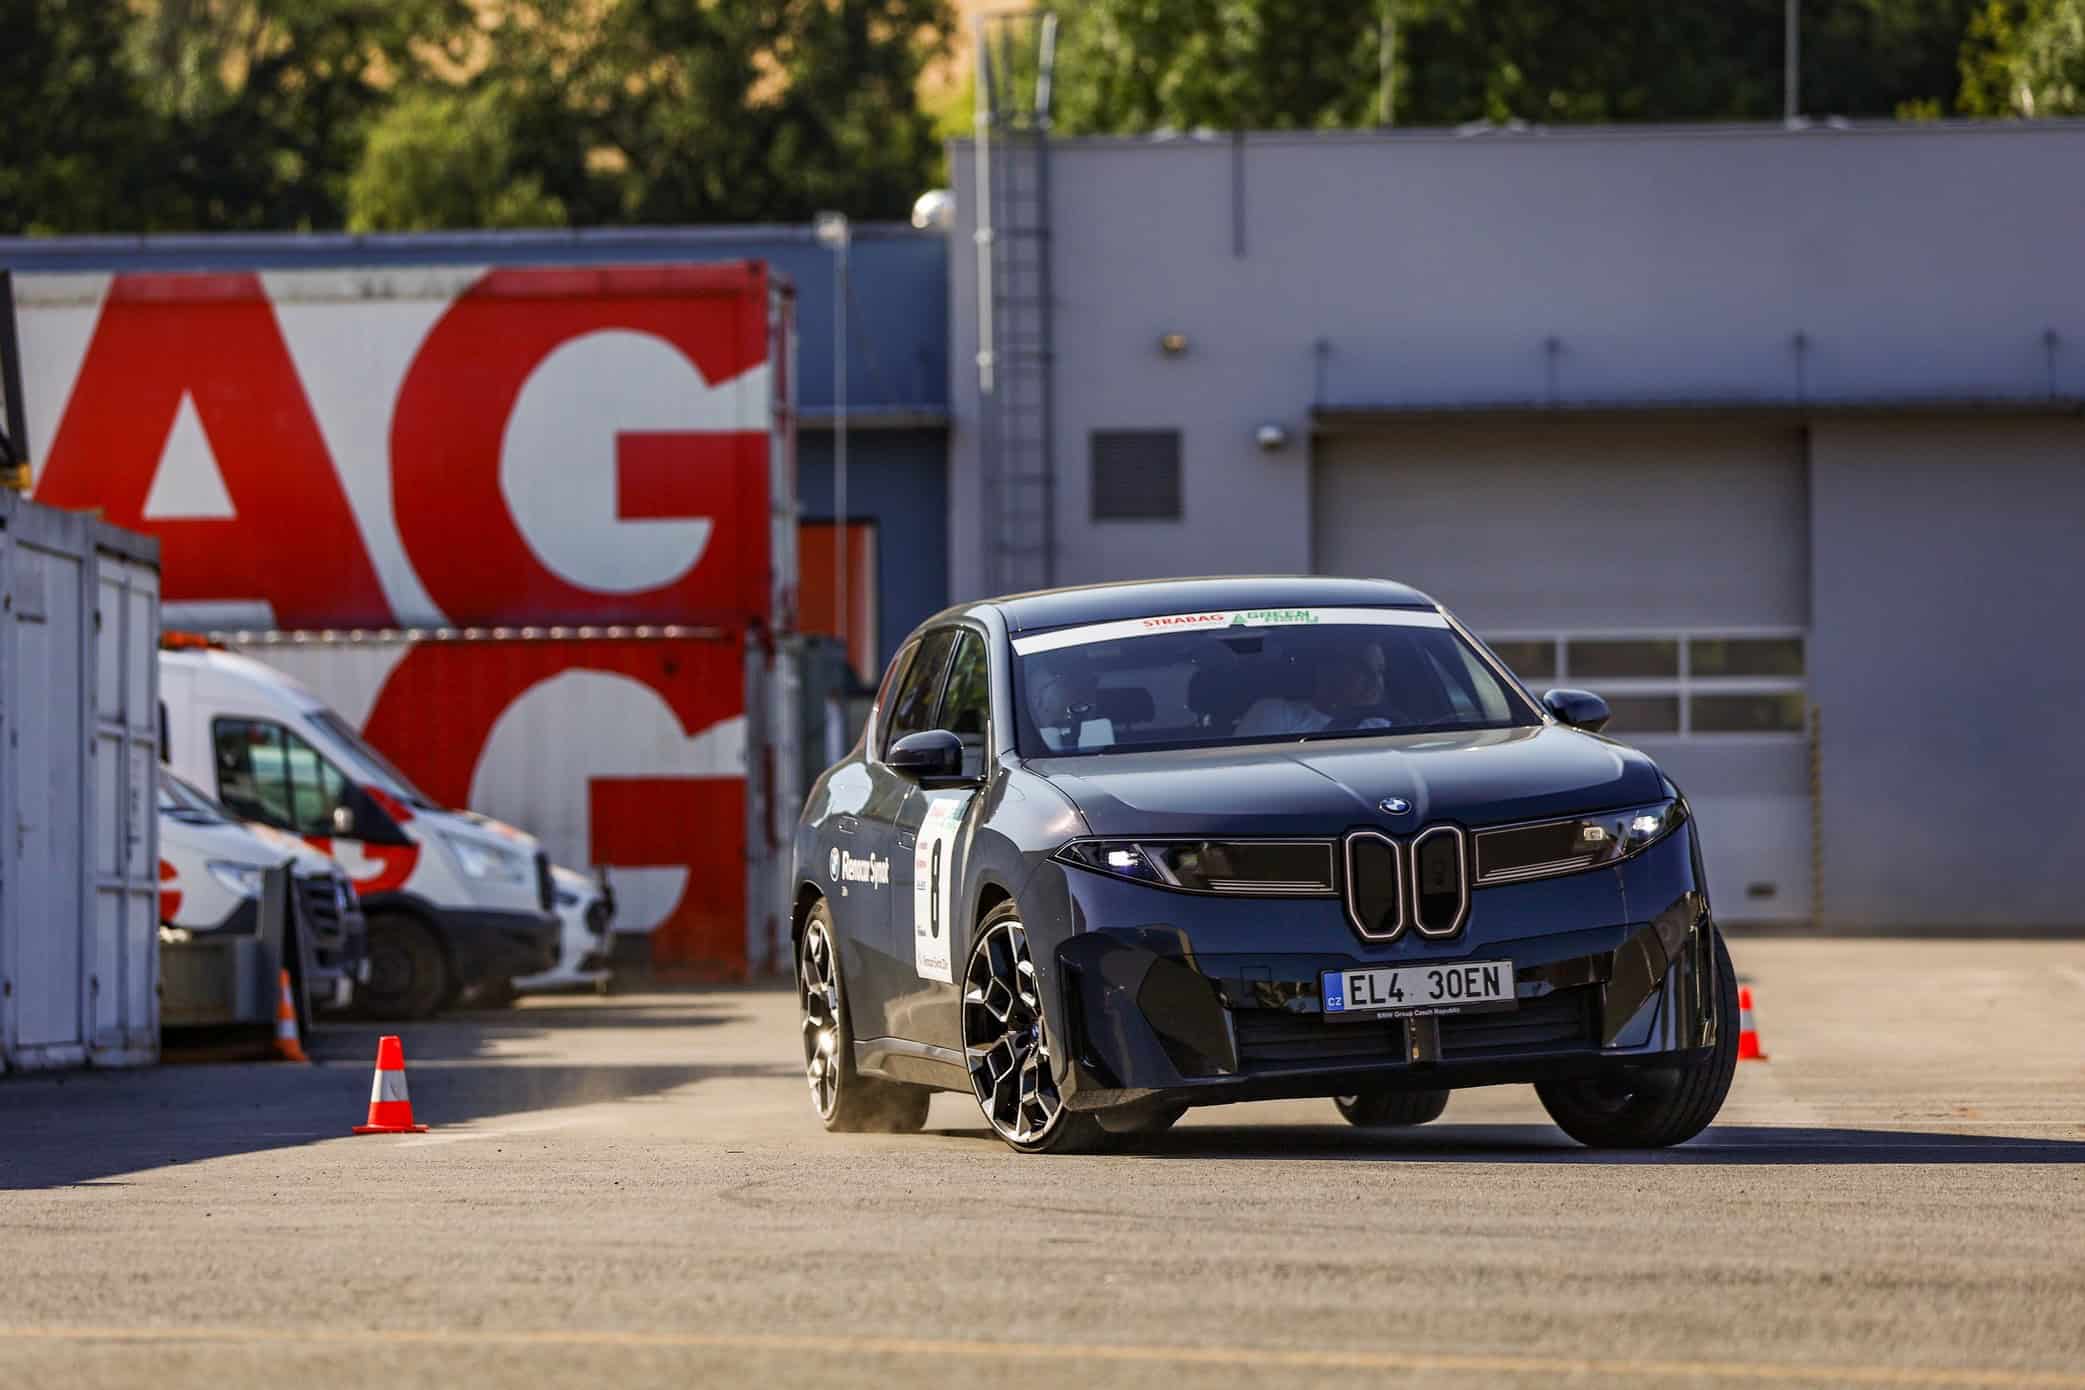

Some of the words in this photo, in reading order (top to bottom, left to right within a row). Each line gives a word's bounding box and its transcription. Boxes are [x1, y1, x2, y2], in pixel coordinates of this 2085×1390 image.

[1143, 614, 1225, 627] STRABAG
[1247, 610, 1310, 620] GREEN
[1349, 973, 1404, 1005] EL4
[1428, 966, 1500, 999] 30EN
[1327, 996, 1342, 1007] CZ
